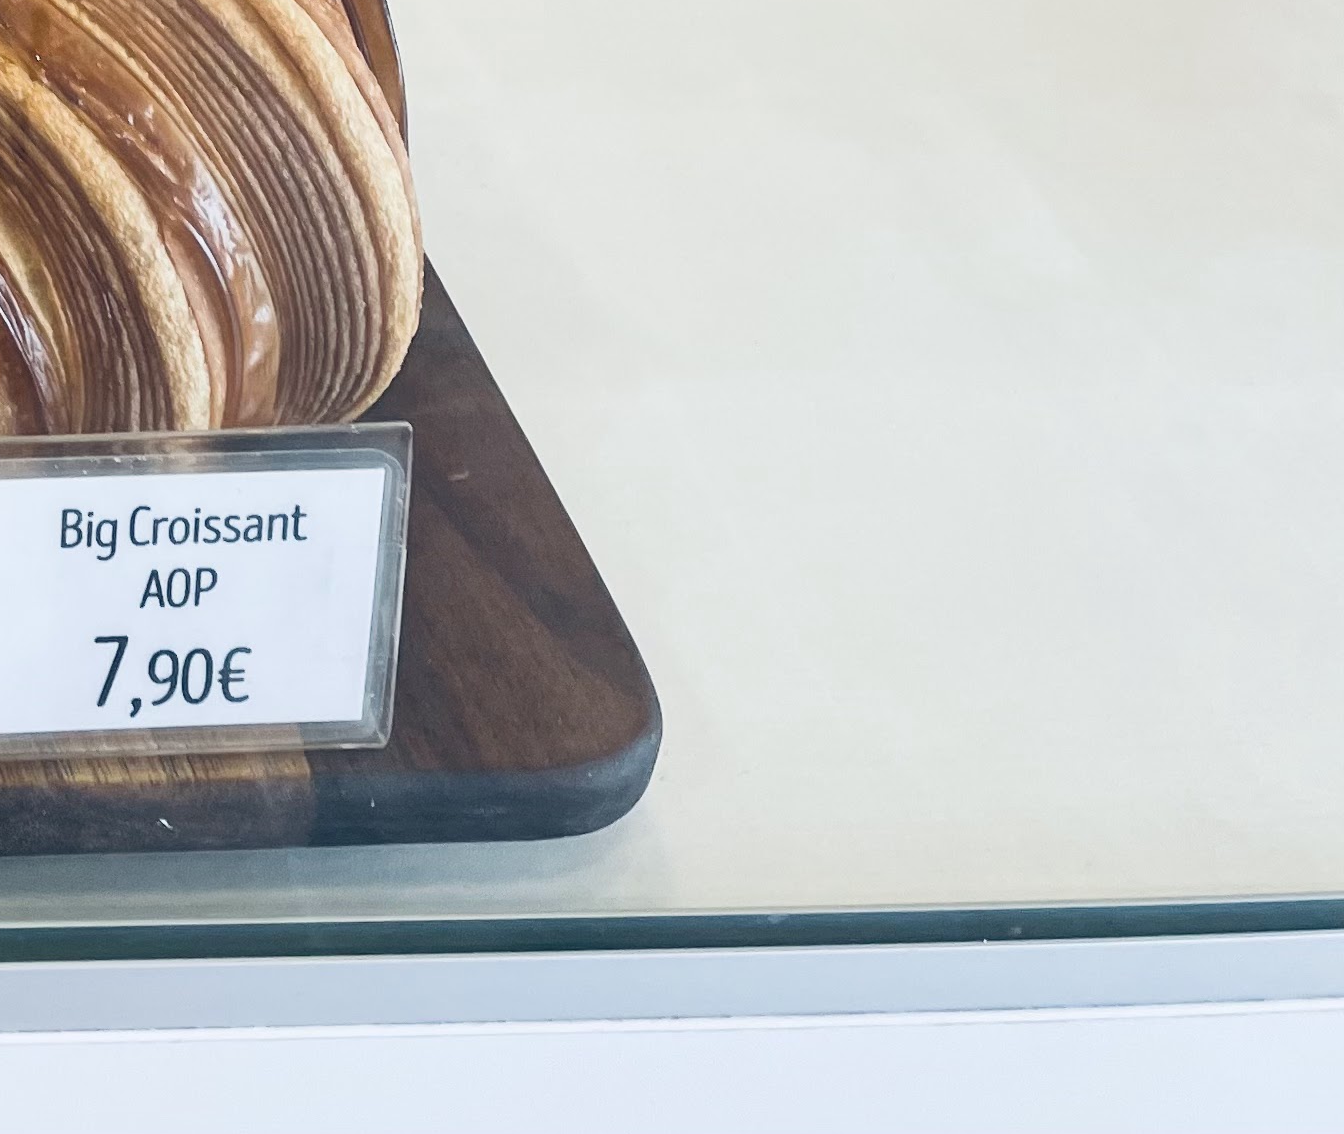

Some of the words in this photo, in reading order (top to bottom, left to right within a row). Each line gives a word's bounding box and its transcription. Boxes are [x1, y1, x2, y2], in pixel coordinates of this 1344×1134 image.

[60, 508, 119, 561] Big
[128, 504, 308, 548] Croissant
[139, 567, 219, 609] AOP
[94, 635, 253, 718] 7,90€
